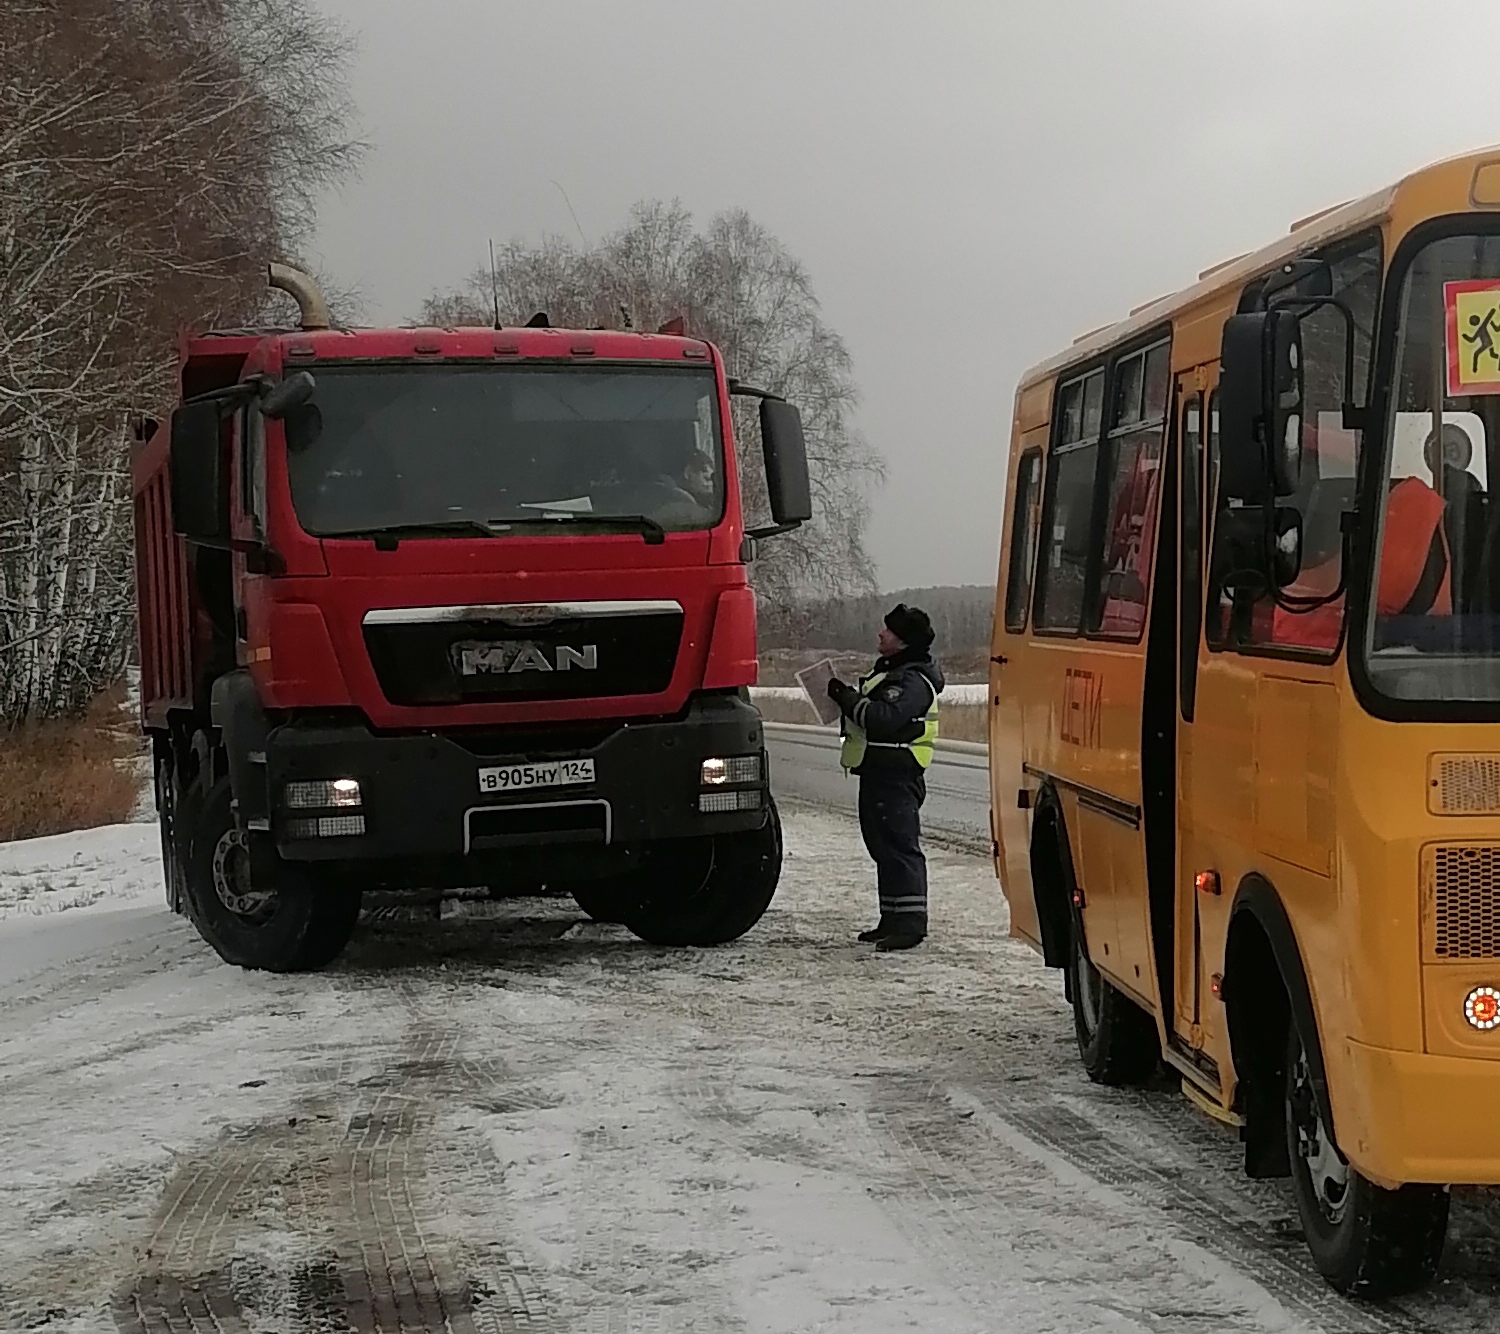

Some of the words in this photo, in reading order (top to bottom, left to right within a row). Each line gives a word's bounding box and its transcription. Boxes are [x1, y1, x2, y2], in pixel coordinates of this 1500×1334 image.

[461, 644, 598, 676] MAN
[1060, 668, 1104, 752] ДЕТИ
[561, 762, 593, 778] 124
